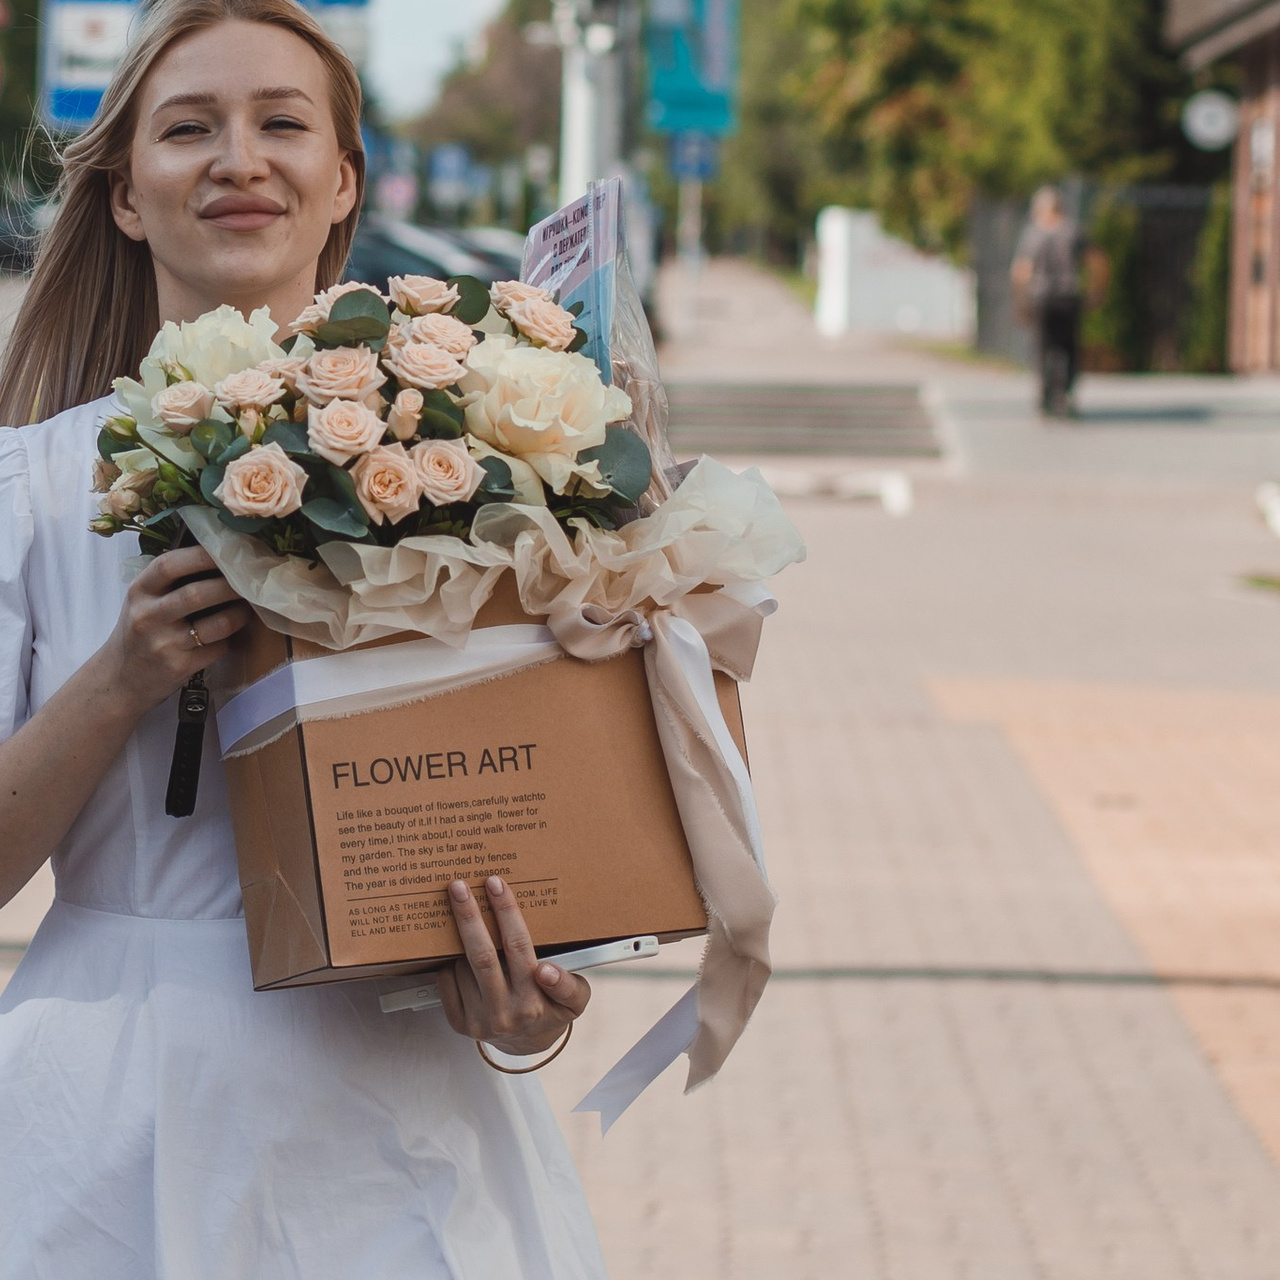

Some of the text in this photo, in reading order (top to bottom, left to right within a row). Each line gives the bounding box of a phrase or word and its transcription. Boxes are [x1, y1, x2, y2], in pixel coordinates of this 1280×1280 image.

[332, 744, 537, 789] FLOWER ART
[336, 811, 354, 821] Life
[357, 809, 373, 819] like
[376, 809, 382, 817] a
[384, 804, 423, 816] bouquet
[425, 802, 434, 811] of
[511, 792, 546, 803] watchto
[338, 826, 355, 835] see
[357, 823, 372, 833] the
[374, 820, 405, 831] beauty
[407, 818, 416, 828] of
[439, 814, 456, 825] had
[458, 815, 465, 823] a
[466, 811, 492, 822] single
[497, 808, 524, 819] flower
[526, 806, 539, 816] for
[340, 839, 366, 849] every
[396, 832, 420, 843] think
[456, 826, 481, 837] could
[483, 824, 504, 834] walk
[506, 820, 537, 832] forever
[539, 819, 548, 829] in
[341, 854, 356, 864] my
[359, 850, 396, 863] garden.
[397, 847, 416, 857] The
[418, 845, 434, 856] sky
[436, 844, 444, 853] is
[446, 842, 458, 852] far
[343, 852, 518, 877] and the world is surrounded by fences
[344, 867, 513, 891] The year is divided into four seasons.
[530, 899, 548, 908] LIVE
[550, 897, 558, 906] W
[540, 887, 558, 896] LIFE
[348, 898, 450, 916] AS LONG AS THERE ARE
[349, 909, 454, 927] WILL NOT BE ACCOMPAN
[351, 920, 447, 937] ELL AND MEET SLOWLY
